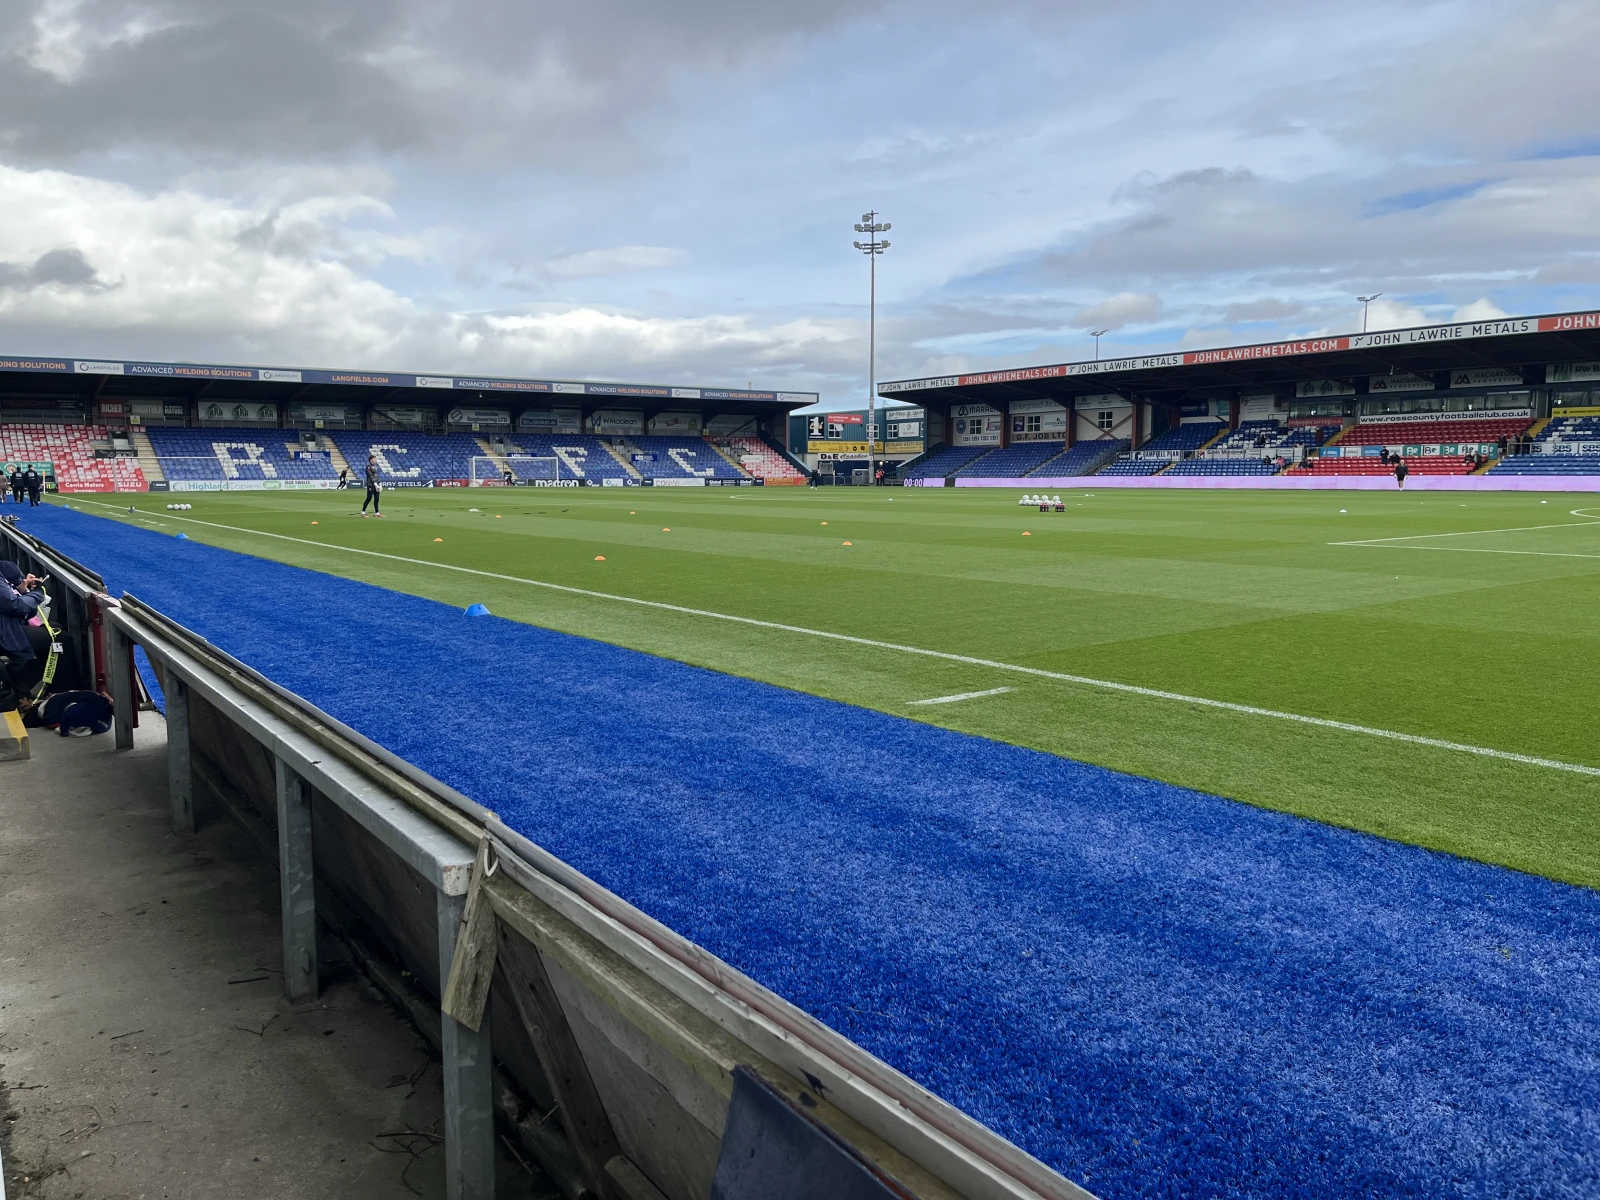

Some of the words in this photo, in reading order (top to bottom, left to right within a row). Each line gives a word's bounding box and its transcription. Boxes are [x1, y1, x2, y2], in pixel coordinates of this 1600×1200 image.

[1553, 314, 1600, 330] JOHN
[1367, 333, 1401, 347] JOHN
[1410, 326, 1462, 342] LAWRIE
[1472, 320, 1529, 336] METALS
[1192, 339, 1338, 363] JOHNLAWRIEMETALS.COM
[19, 361, 66, 371] SOLUTIONS
[1076, 363, 1099, 374] JOHN
[1104, 359, 1137, 371] LAWRIE
[1142, 356, 1178, 368] METALS
[131, 366, 174, 375] ADVANCED
[175, 368, 210, 376] WELDING
[211, 368, 252, 378] SOLUTIONS
[964, 367, 1060, 385] JOHNLAWRIEMETALS.COM
[331, 375, 389, 384] LANGFIELDS.COM
[458, 380, 490, 388] ADVANCED
[491, 382, 517, 390] WELDING
[886, 382, 902, 392] JOHN
[904, 380, 927, 390] LAWRIE
[930, 377, 955, 388] METALS
[1360, 410, 1529, 423] www.rosscountyfootballclub.co.uk
[1033, 432, 1050, 440] JOB
[188, 482, 229, 490] Highland
[229, 482, 260, 490] Copiers
[535, 479, 580, 488] macron
[903, 478, 923, 487] 00:00
